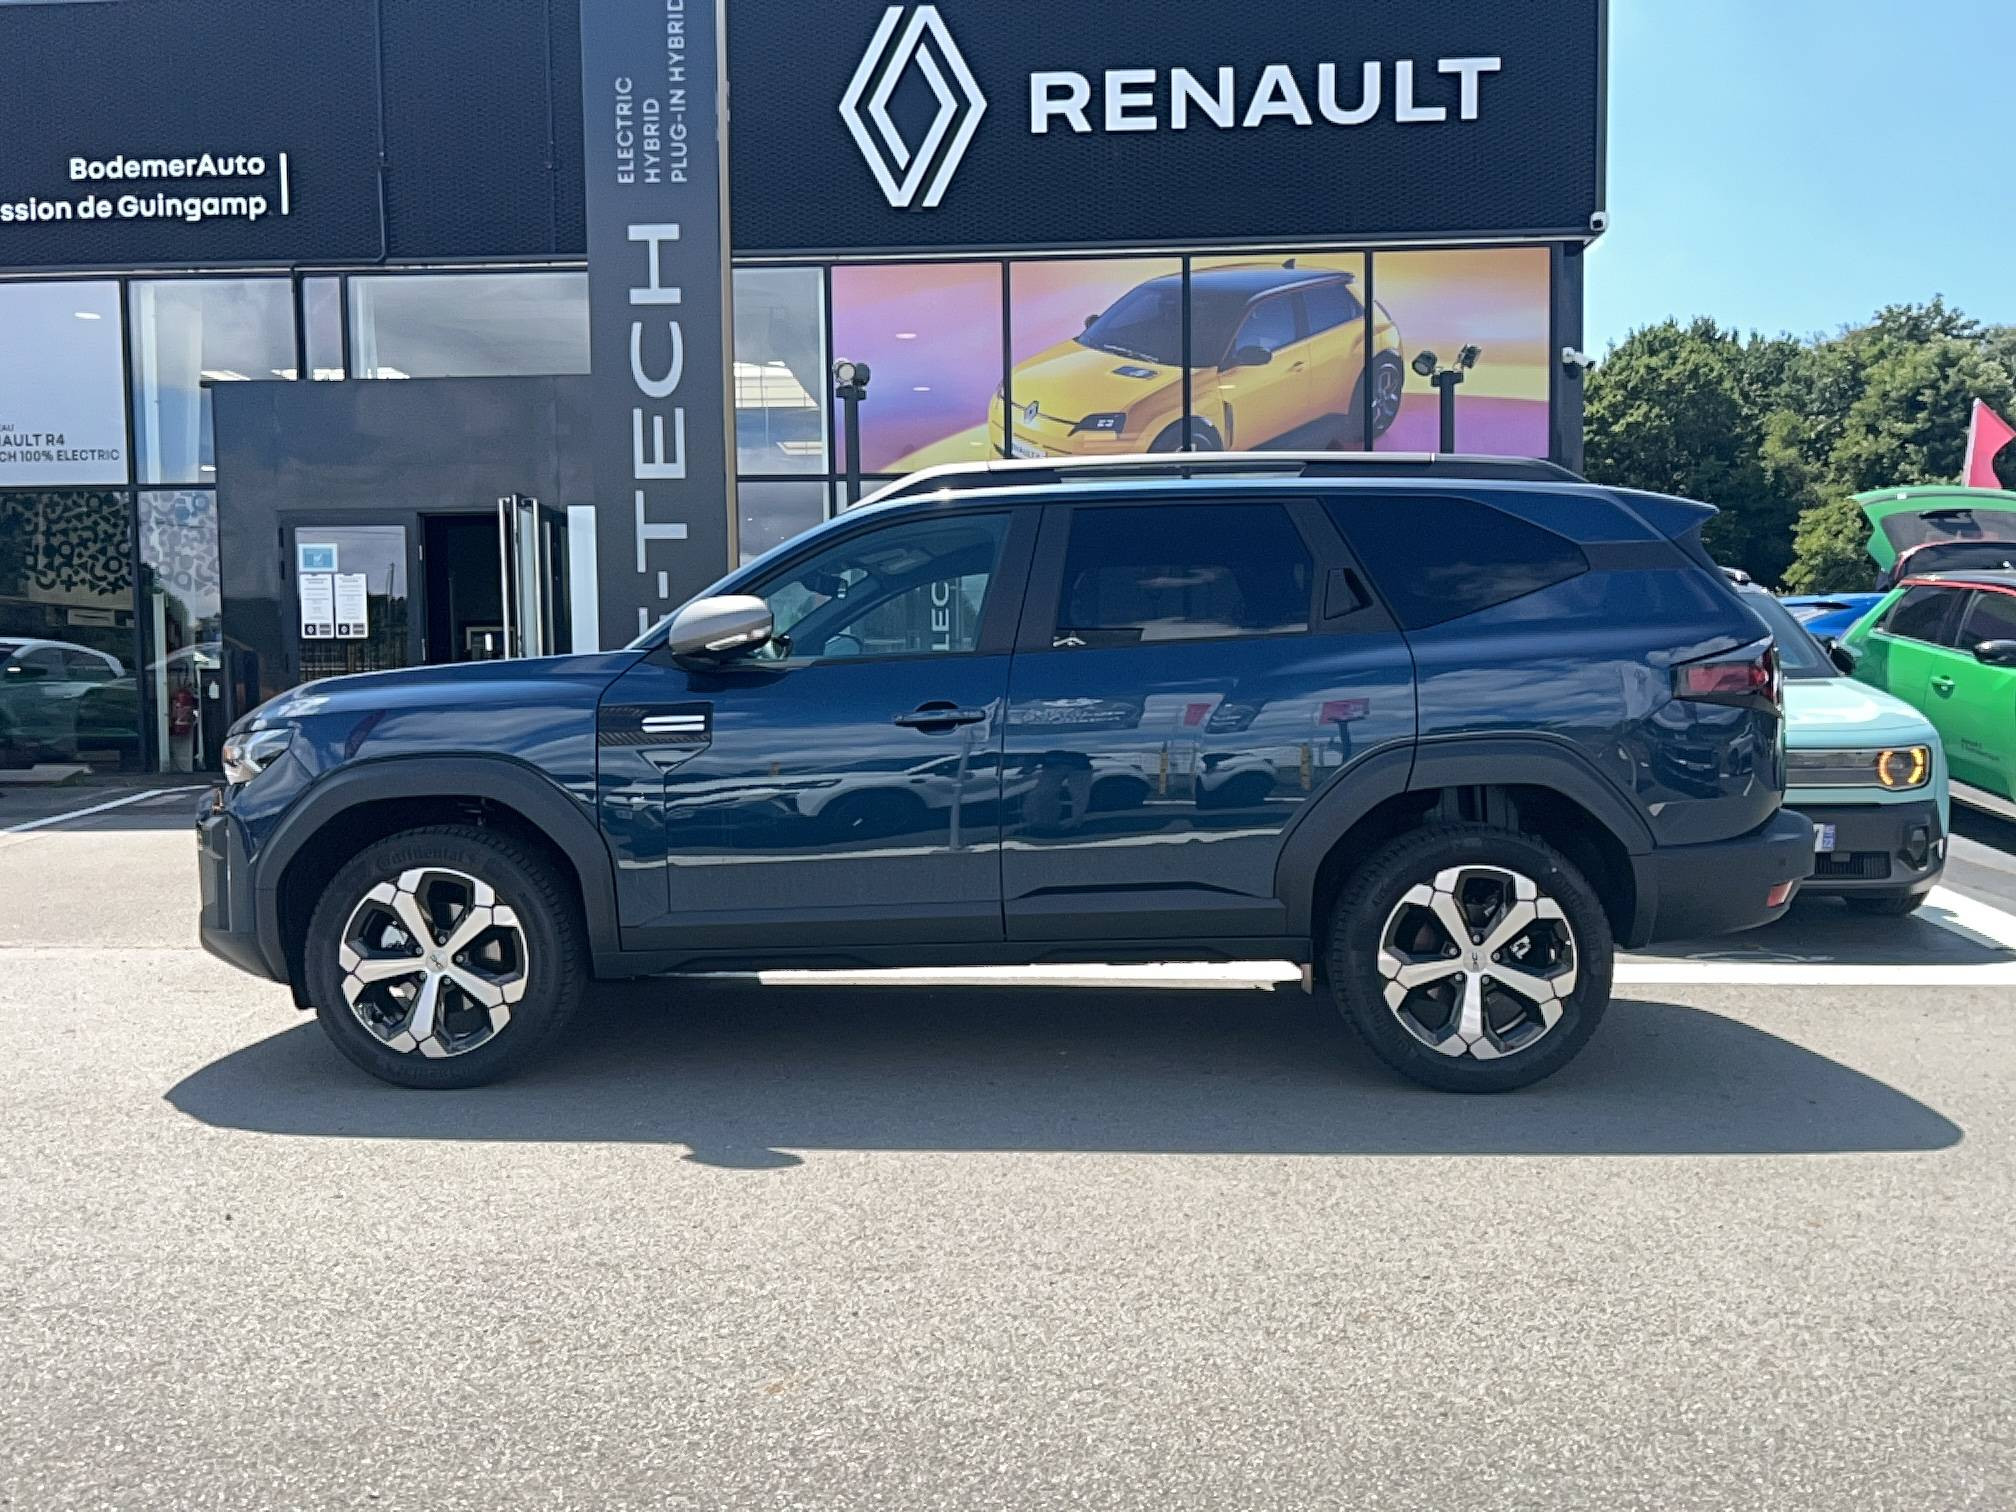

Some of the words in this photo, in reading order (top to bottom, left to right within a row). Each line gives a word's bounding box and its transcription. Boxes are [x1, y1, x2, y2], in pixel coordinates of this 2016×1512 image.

[667, 0, 685, 82] HYBRID
[1030, 56, 1502, 134] RENAULT
[615, 77, 635, 184] ELECTRIC
[642, 98, 661, 183] HYBRID
[669, 89, 688, 183] PLUG-IN
[69, 153, 266, 180] BodemerAuto
[0, 196, 72, 222] ssion
[77, 195, 113, 219] de
[117, 193, 267, 222] Guingamp
[0, 424, 15, 432] AU
[0, 433, 42, 447] AULT
[45, 433, 65, 446] R4
[19, 450, 54, 463] 100%
[56, 448, 120, 462] ELECTRIC
